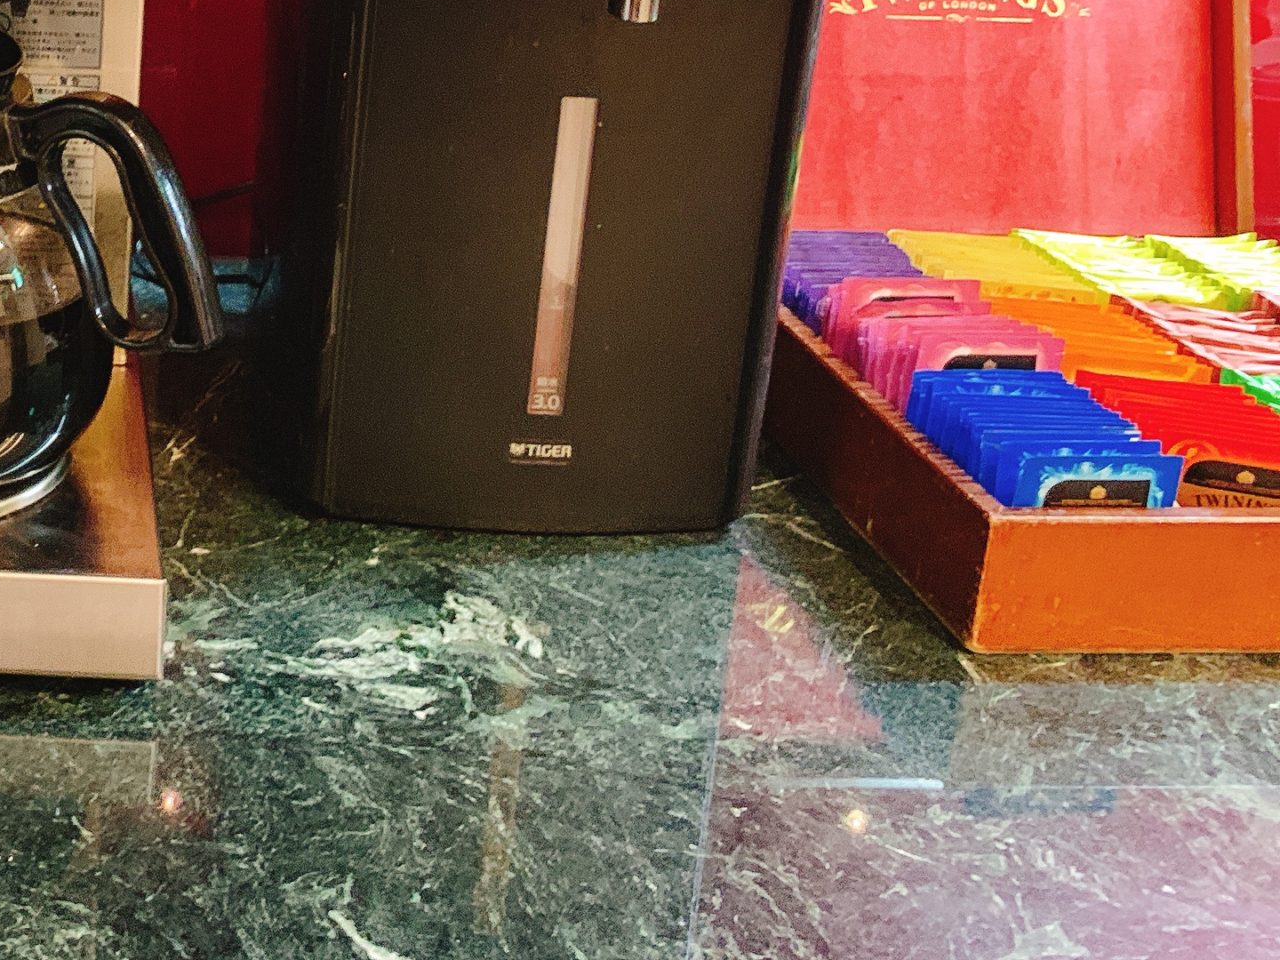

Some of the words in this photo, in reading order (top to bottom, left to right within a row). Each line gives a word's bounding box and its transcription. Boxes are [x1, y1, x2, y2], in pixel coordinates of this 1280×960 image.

[918, 1, 935, 11] OF
[942, 0, 997, 12] LONDON
[533, 393, 561, 411] 3.0
[526, 443, 573, 458] TIGER
